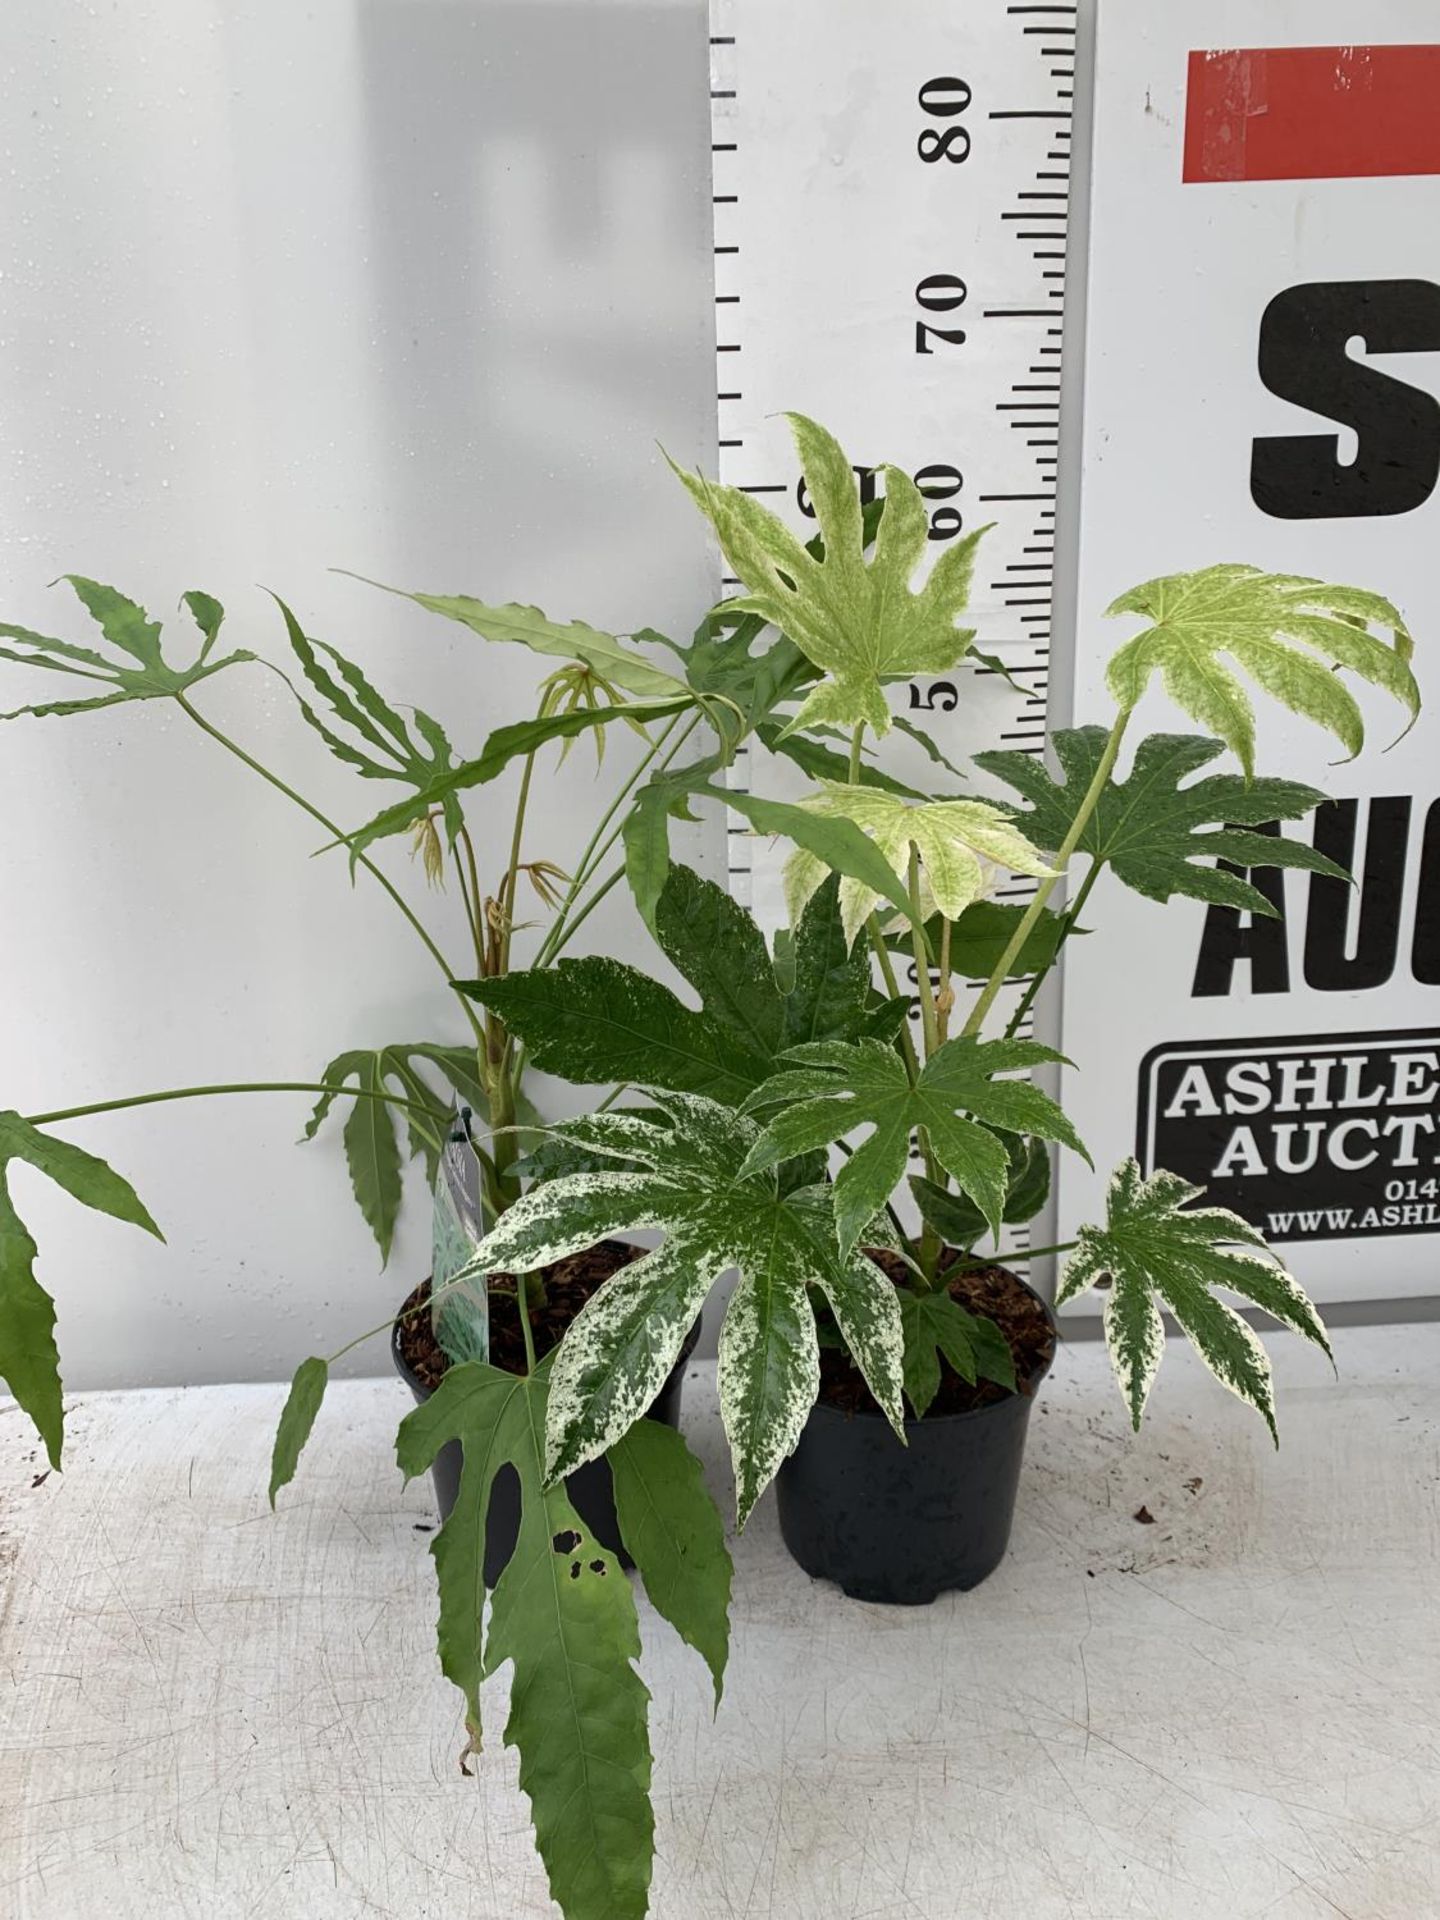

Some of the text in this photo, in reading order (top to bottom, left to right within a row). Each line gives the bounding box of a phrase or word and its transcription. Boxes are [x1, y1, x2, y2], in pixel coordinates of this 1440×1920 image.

[917, 76, 972, 164] 80
[915, 273, 968, 355] 70
[1250, 278, 1440, 520] S
[913, 464, 963, 541] 60
[909, 681, 959, 712] 5
[1164, 1052, 1440, 1118] ASHLE
[1211, 1113, 1440, 1178] AUCT
